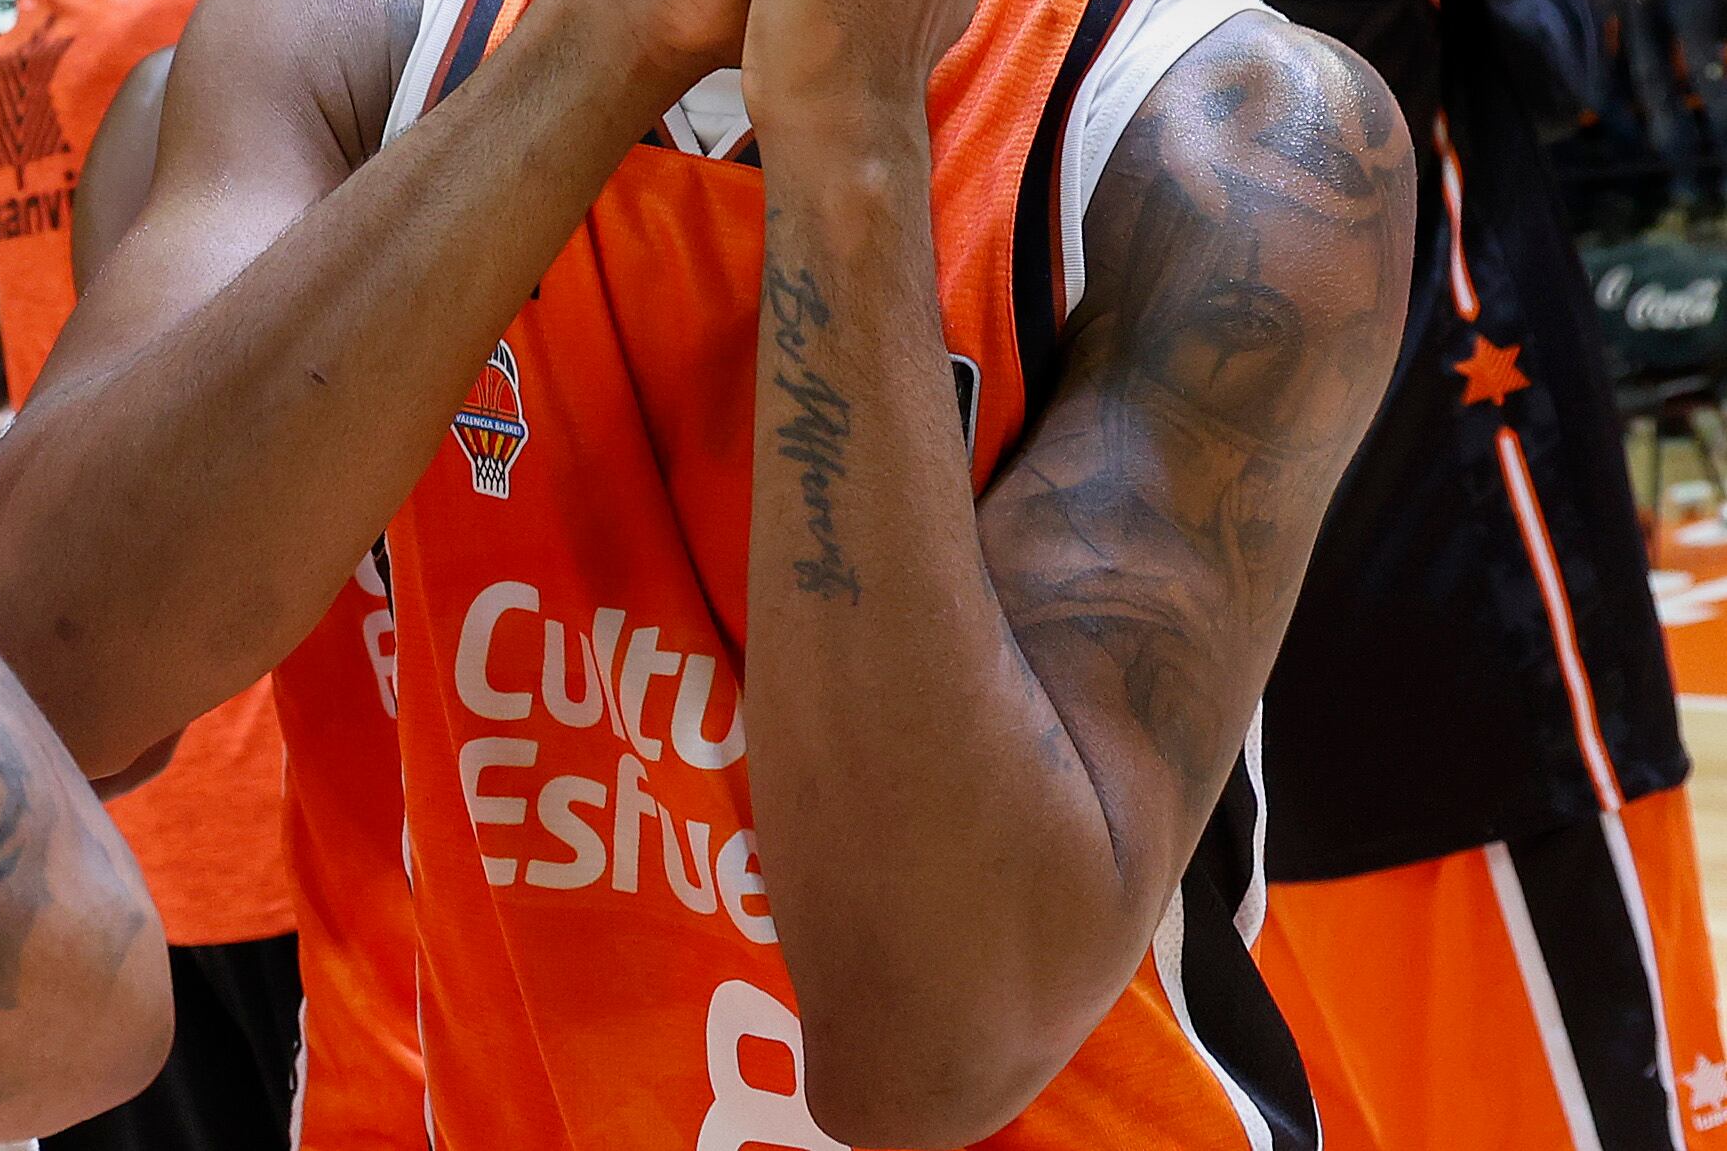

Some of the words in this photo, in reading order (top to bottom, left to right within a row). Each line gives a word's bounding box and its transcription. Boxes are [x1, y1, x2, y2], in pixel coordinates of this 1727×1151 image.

[455, 413, 493, 430] VALENCIA
[494, 421, 522, 437] BASKET
[455, 580, 747, 770] Cultu
[458, 736, 780, 944] Esfue
